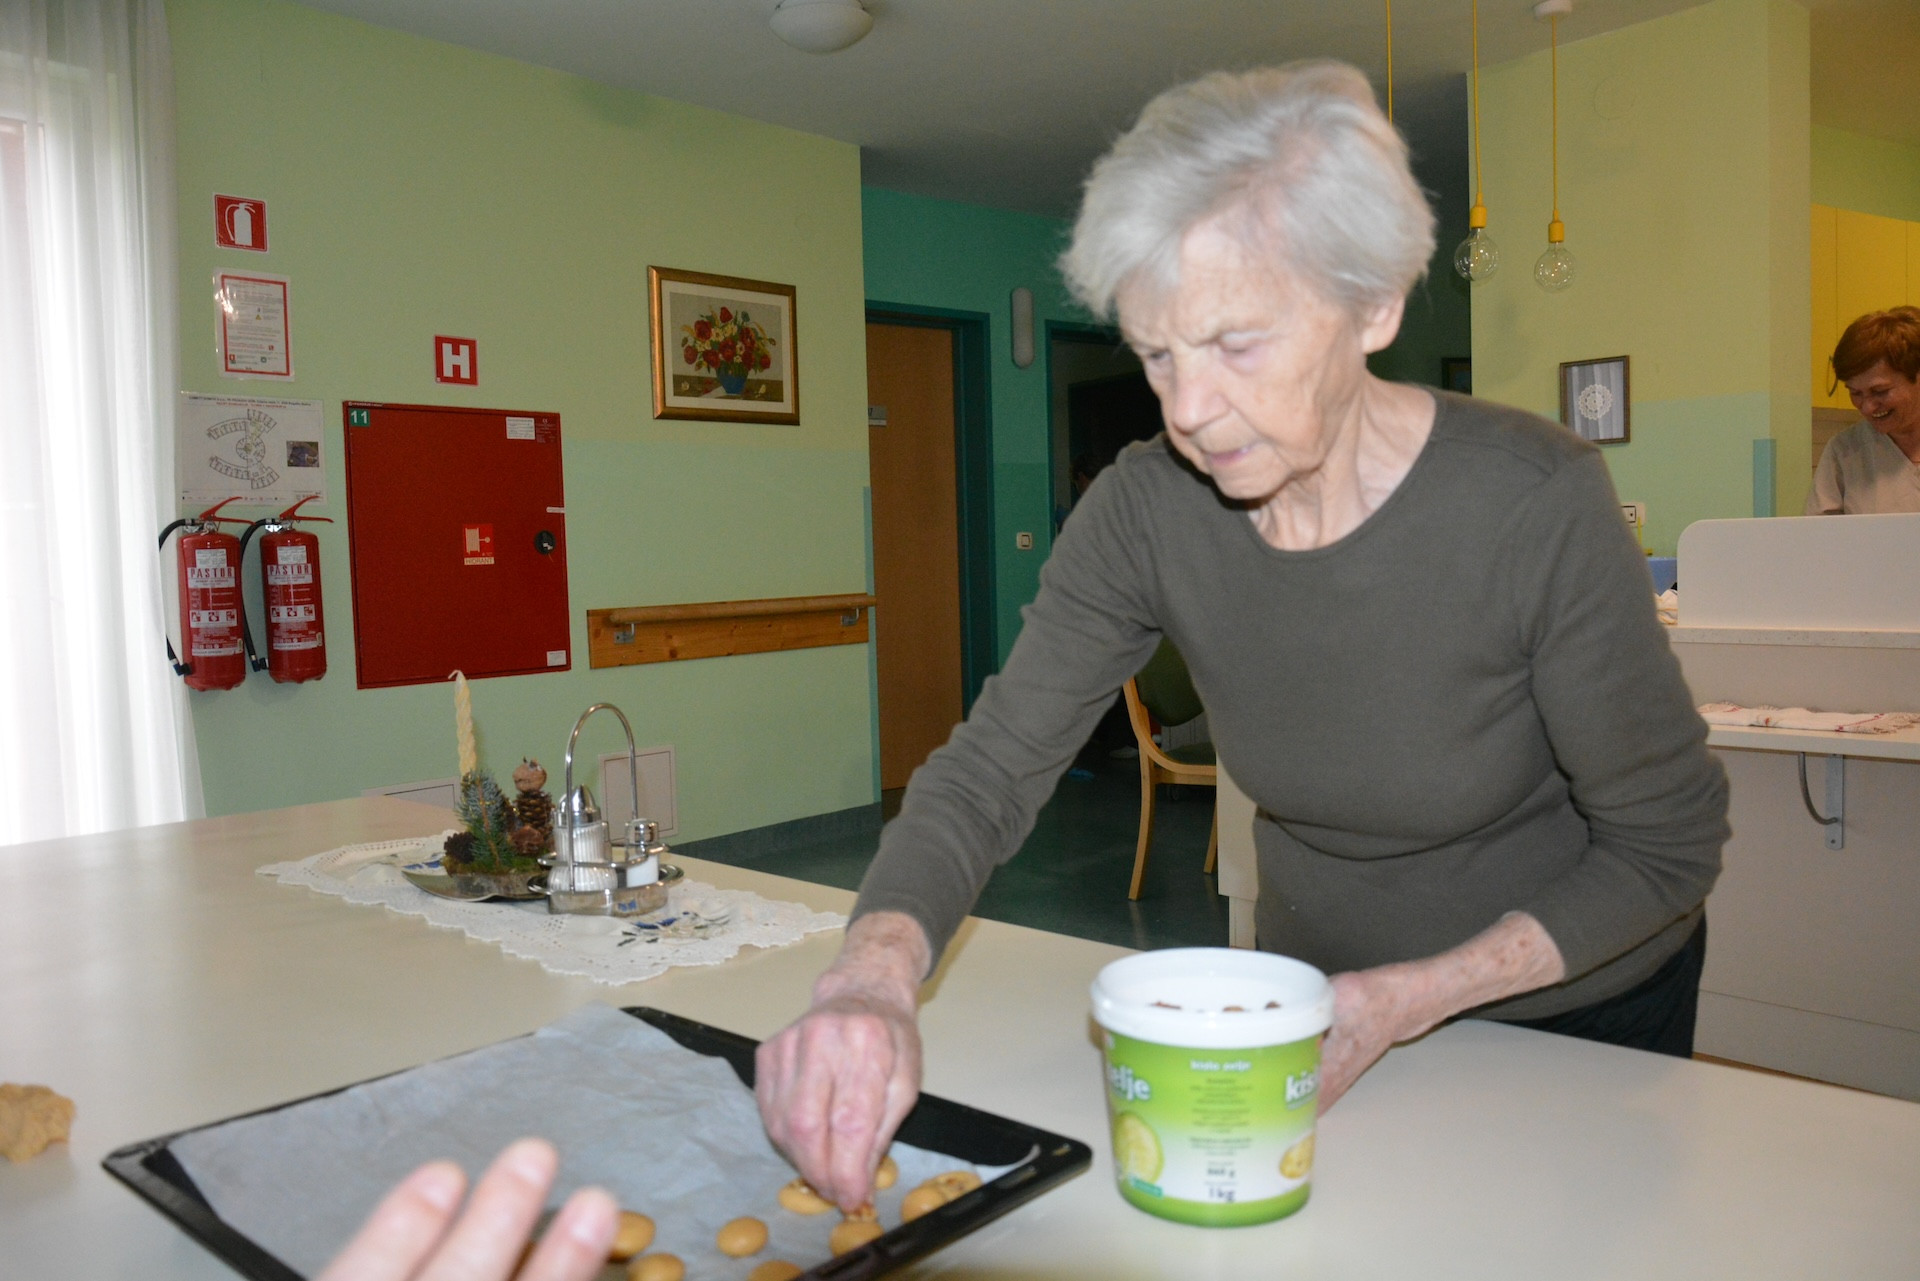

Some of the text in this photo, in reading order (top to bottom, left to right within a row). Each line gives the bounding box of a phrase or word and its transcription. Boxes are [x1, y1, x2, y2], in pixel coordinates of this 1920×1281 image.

[442, 343, 471, 379] H
[351, 410, 368, 424] 11
[190, 567, 234, 578] PASTOR
[270, 565, 310, 576] PASTOR
[1109, 1064, 1151, 1101] elje
[1286, 1071, 1319, 1103] kis
